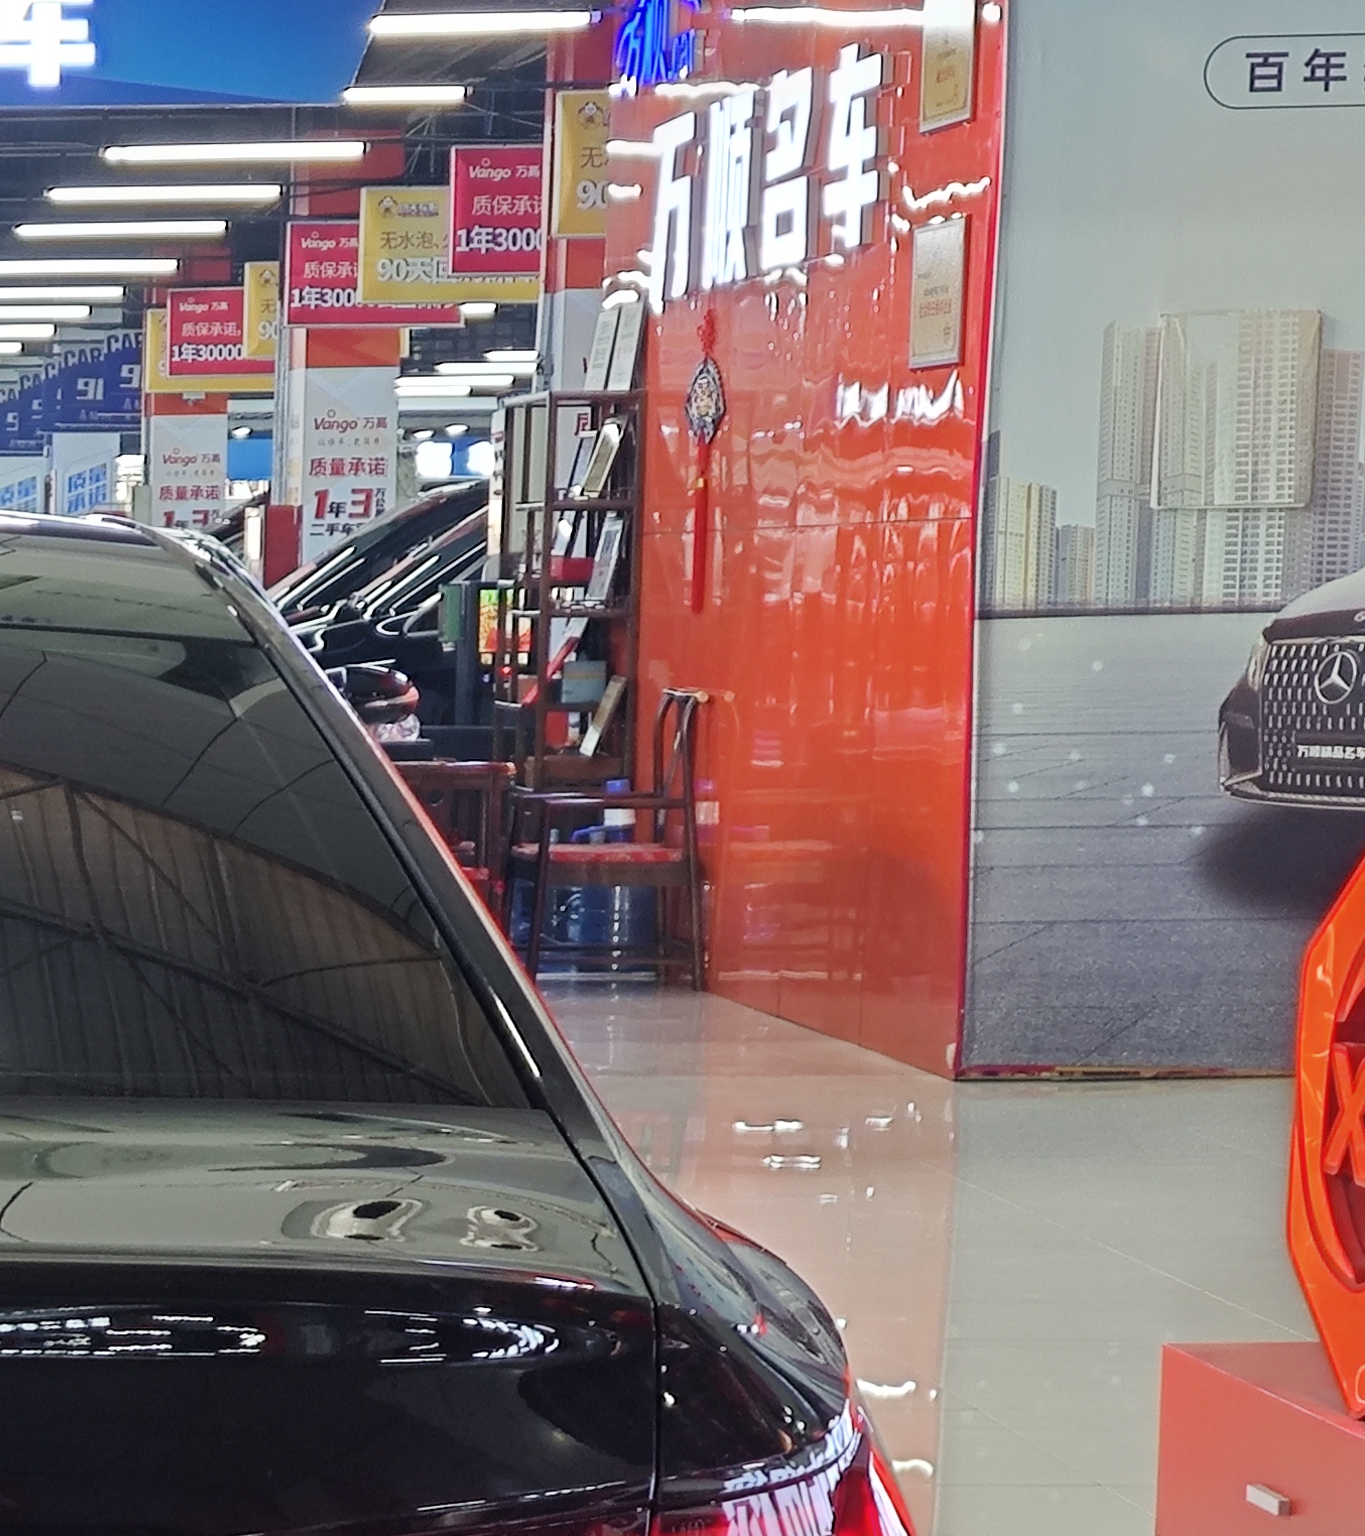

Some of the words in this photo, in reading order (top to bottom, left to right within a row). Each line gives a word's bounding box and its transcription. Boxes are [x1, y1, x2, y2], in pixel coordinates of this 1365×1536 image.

[1246, 48, 1365, 92] 百年
[469, 158, 511, 182] Vango
[648, 44, 884, 302] 万顺名车
[472, 195, 541, 216] 质保承
[301, 231, 336, 251] Vango
[380, 231, 448, 249] 无水泡、
[303, 261, 358, 279] 质保承
[314, 409, 358, 433] Vango
[162, 448, 197, 468] Vango
[309, 457, 388, 476] 质量承诺
[310, 523, 365, 537] 二手车
